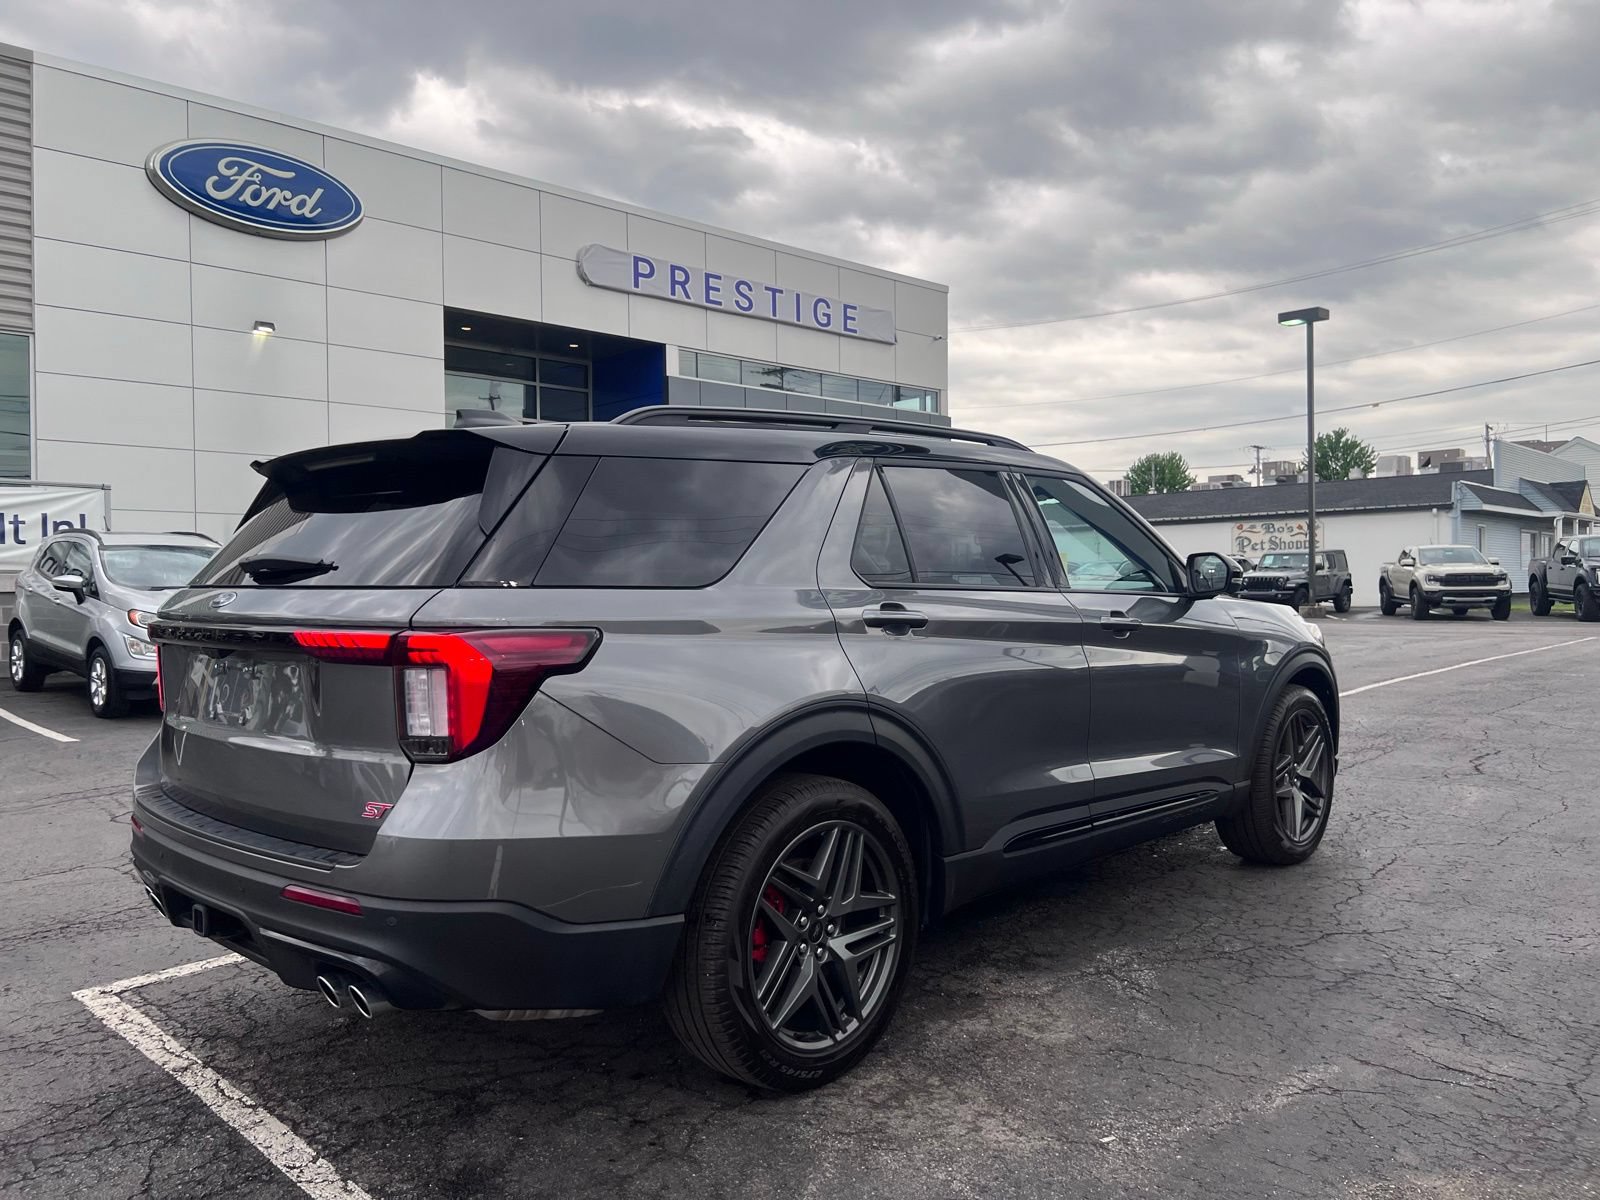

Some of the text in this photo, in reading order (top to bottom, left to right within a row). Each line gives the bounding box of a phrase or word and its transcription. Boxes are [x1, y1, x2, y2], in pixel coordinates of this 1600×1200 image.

[205, 157, 325, 218] Ford
[633, 255, 858, 334] PRESTIGE
[1261, 522, 1294, 534] Bo's
[1235, 536, 1266, 553] Pet
[361, 801, 394, 819] ST
